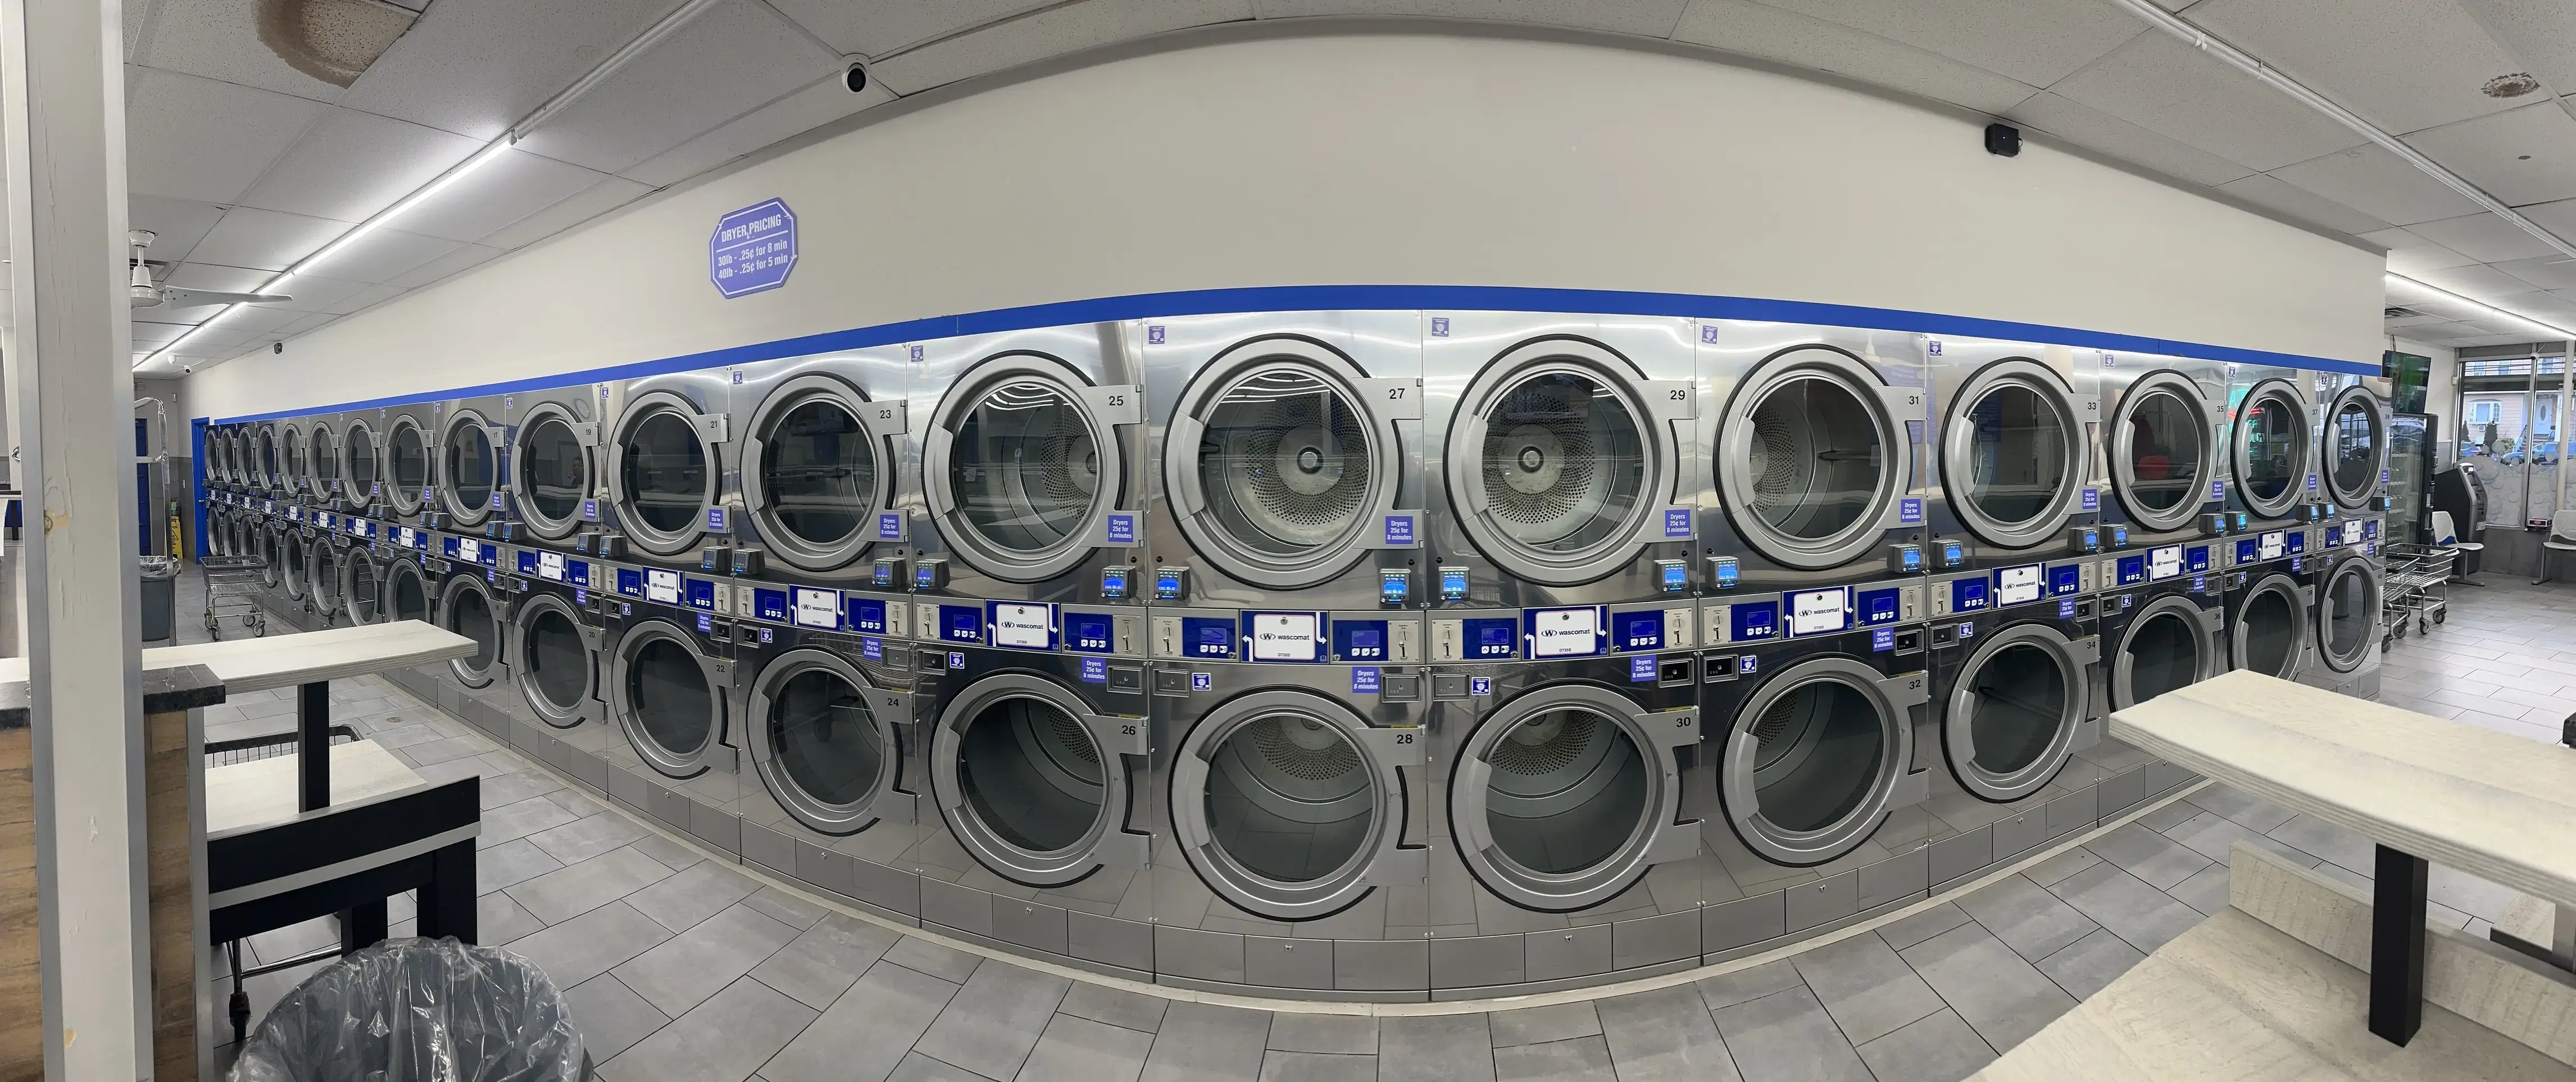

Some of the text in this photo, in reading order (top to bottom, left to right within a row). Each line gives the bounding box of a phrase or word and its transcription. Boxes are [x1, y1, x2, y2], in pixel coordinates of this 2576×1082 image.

[721, 214, 782, 243] DRYER PRICING
[718, 254, 732, 266] 30lb
[739, 248, 754, 261] .25¢
[756, 246, 766, 256] for
[767, 243, 772, 253] 8
[774, 239, 787, 251] min
[719, 267, 733, 279] 40lb
[740, 262, 755, 274] .25¢
[756, 260, 766, 271] for
[768, 257, 773, 266] 5
[774, 253, 788, 266] min
[1389, 388, 1405, 400] 27
[1670, 390, 1685, 400] 29
[1108, 396, 1124, 406] 25
[1909, 396, 1919, 405] 31
[880, 410, 891, 419] 23
[2087, 641, 2096, 649] 34
[716, 664, 725, 673] 22
[1909, 679, 1921, 690] 32
[887, 698, 899, 707] 24
[1676, 717, 1691, 728] 30
[1122, 725, 1136, 735] 26
[1396, 734, 1414, 744] 28
